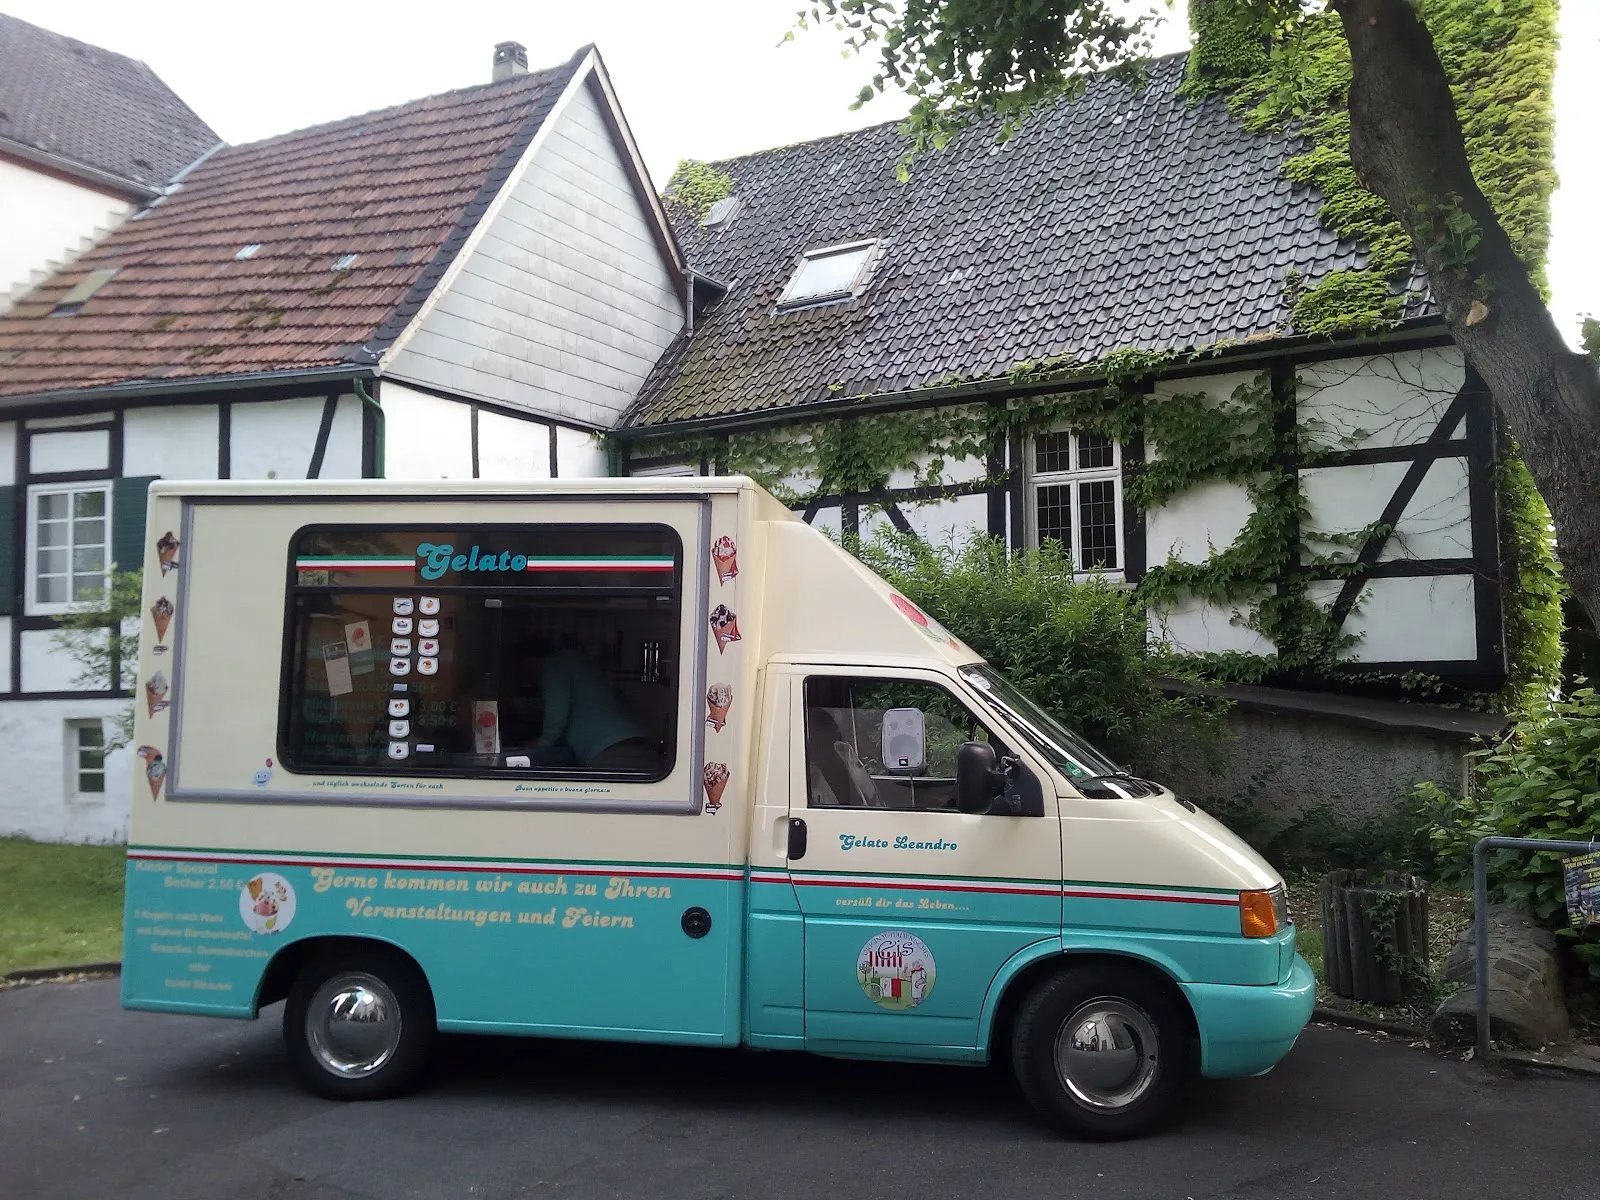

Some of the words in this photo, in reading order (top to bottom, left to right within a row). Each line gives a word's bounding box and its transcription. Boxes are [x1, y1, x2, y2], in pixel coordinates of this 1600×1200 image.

[416, 542, 527, 580] Gelato
[839, 834, 889, 851] Gelato
[893, 835, 958, 851] Leandro
[311, 867, 378, 893] Gerne
[384, 871, 469, 892] kommen
[476, 875, 512, 893] wir
[517, 876, 568, 895] auch
[573, 881, 598, 896] zu
[604, 877, 672, 900] Ihren
[346, 896, 512, 927] Veranstaltungen
[517, 907, 557, 925] und
[562, 906, 635, 928] Feiern
[875, 897, 893, 908] dir
[895, 898, 914, 909] das
[877, 940, 914, 960] Eis
